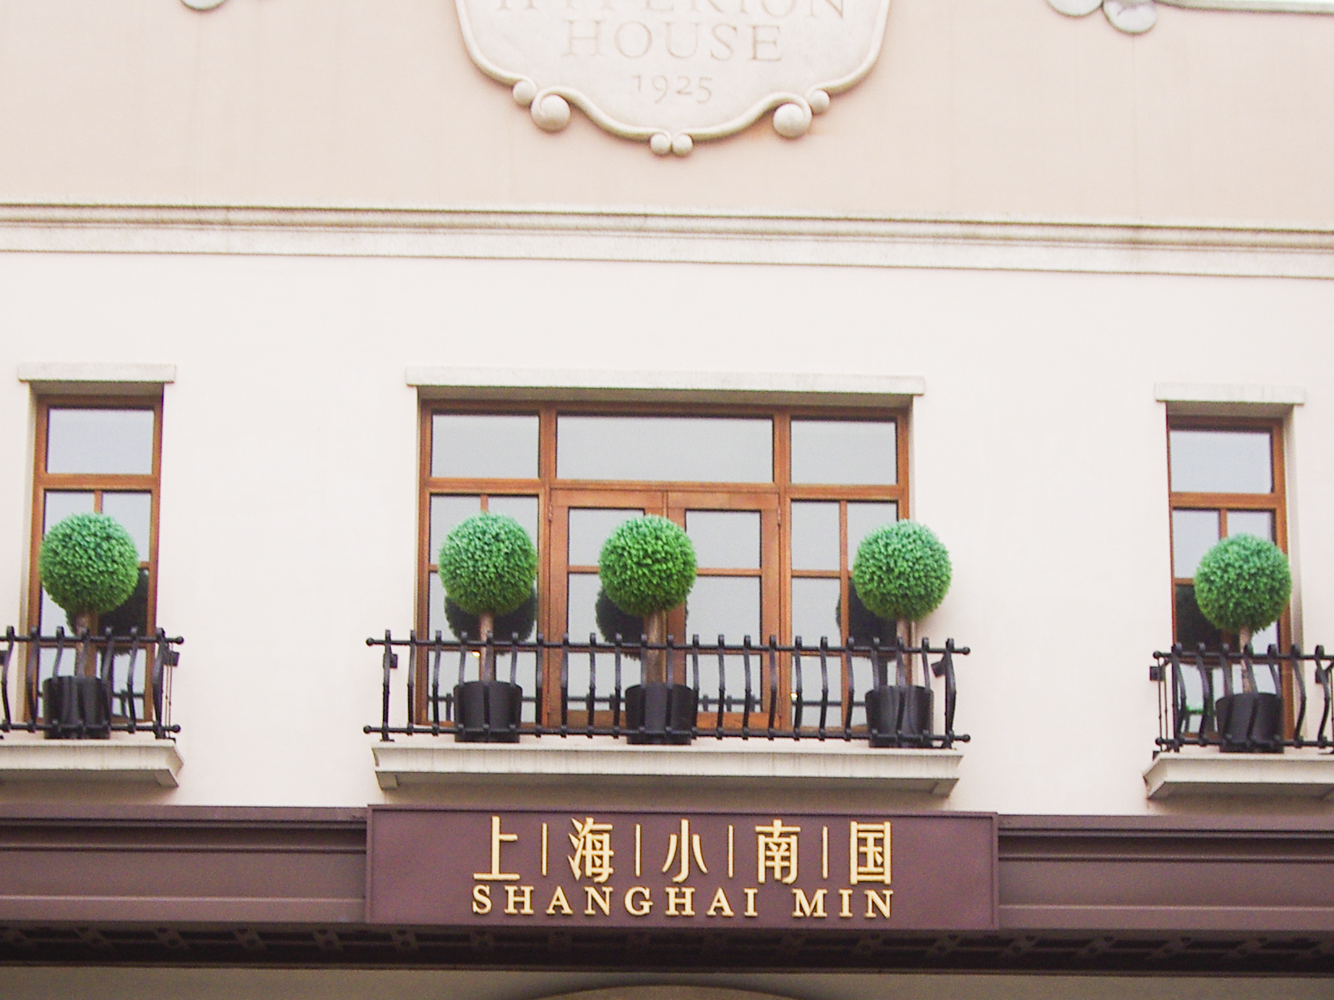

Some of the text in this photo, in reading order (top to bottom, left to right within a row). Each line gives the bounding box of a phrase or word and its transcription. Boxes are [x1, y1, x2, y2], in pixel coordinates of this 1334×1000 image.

[561, 19, 783, 62] HOUSE
[631, 73, 714, 104] 1925
[471, 885, 894, 919] SHANGHAI MIN
